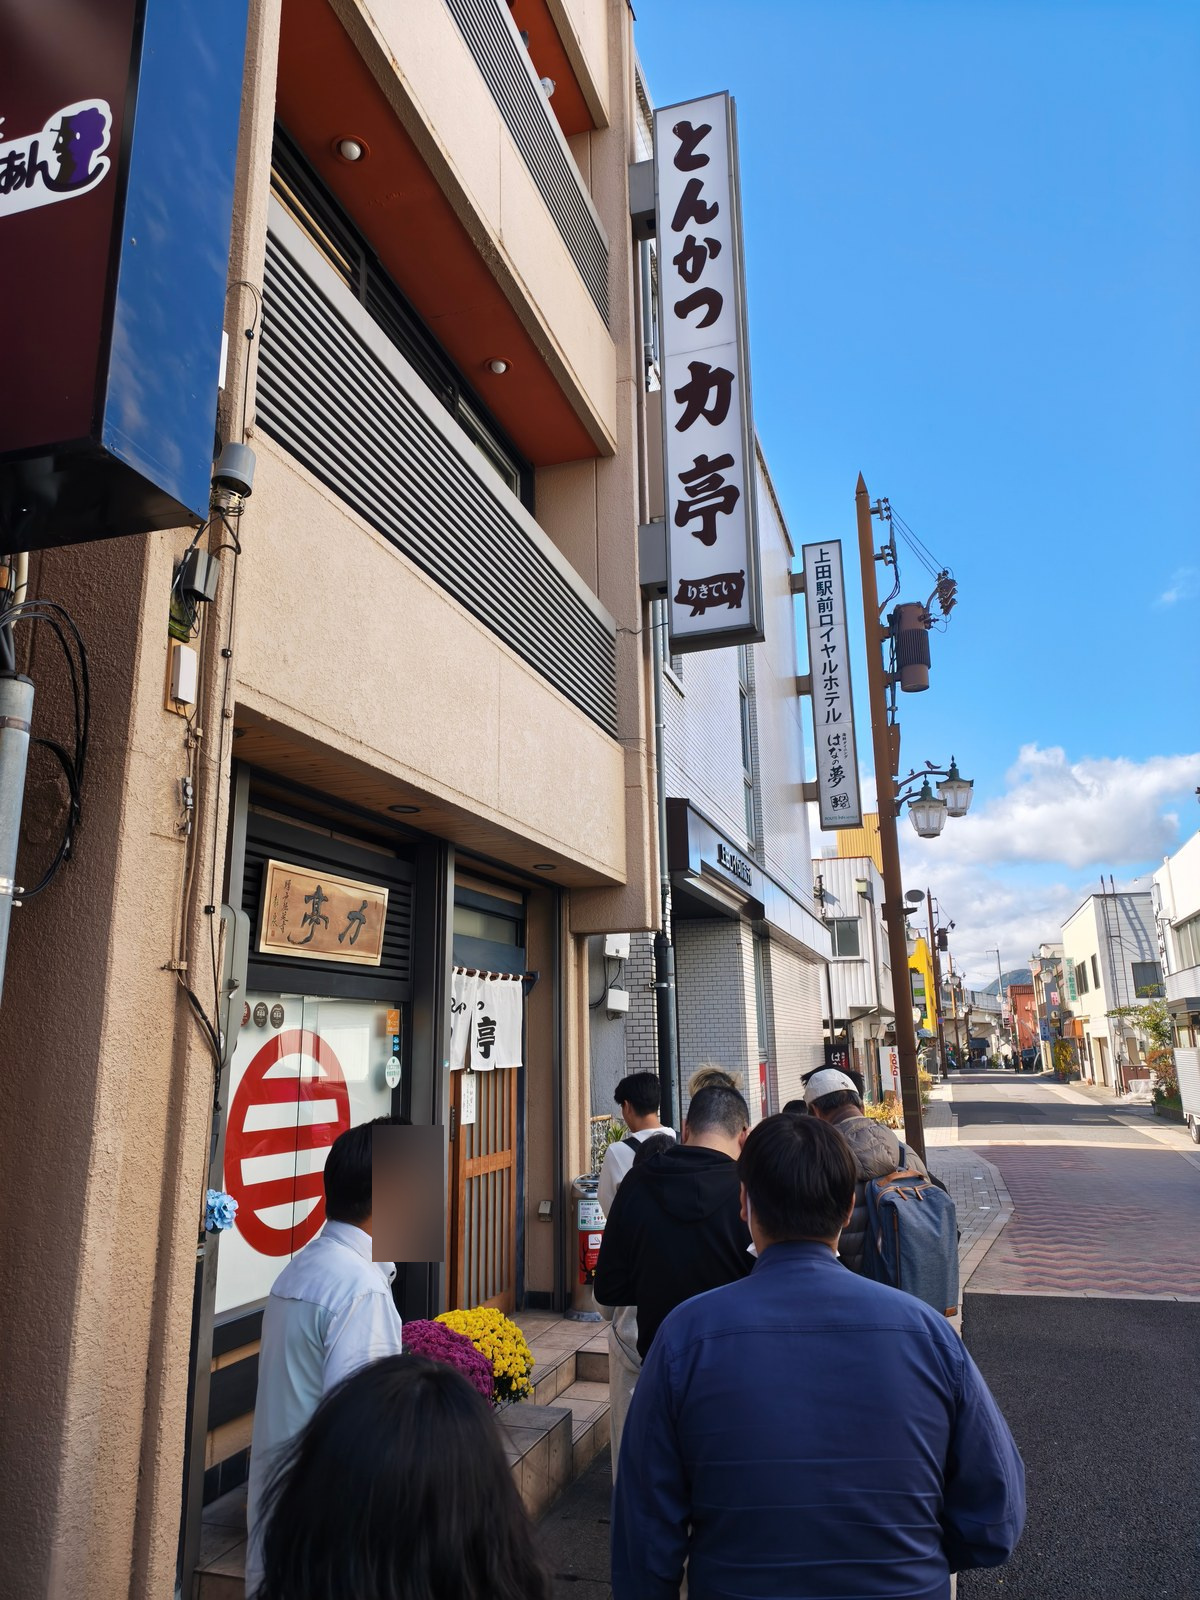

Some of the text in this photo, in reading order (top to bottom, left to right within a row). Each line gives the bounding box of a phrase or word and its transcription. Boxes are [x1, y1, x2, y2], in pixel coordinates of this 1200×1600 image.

[671, 120, 741, 547] とんかつ 力亭
[687, 581, 737, 600] りきてい
[814, 548, 843, 724] 上田駅前ロイヤルホテル
[827, 733, 846, 788] はなの夢
[891, 1053, 899, 1076] DyDo
